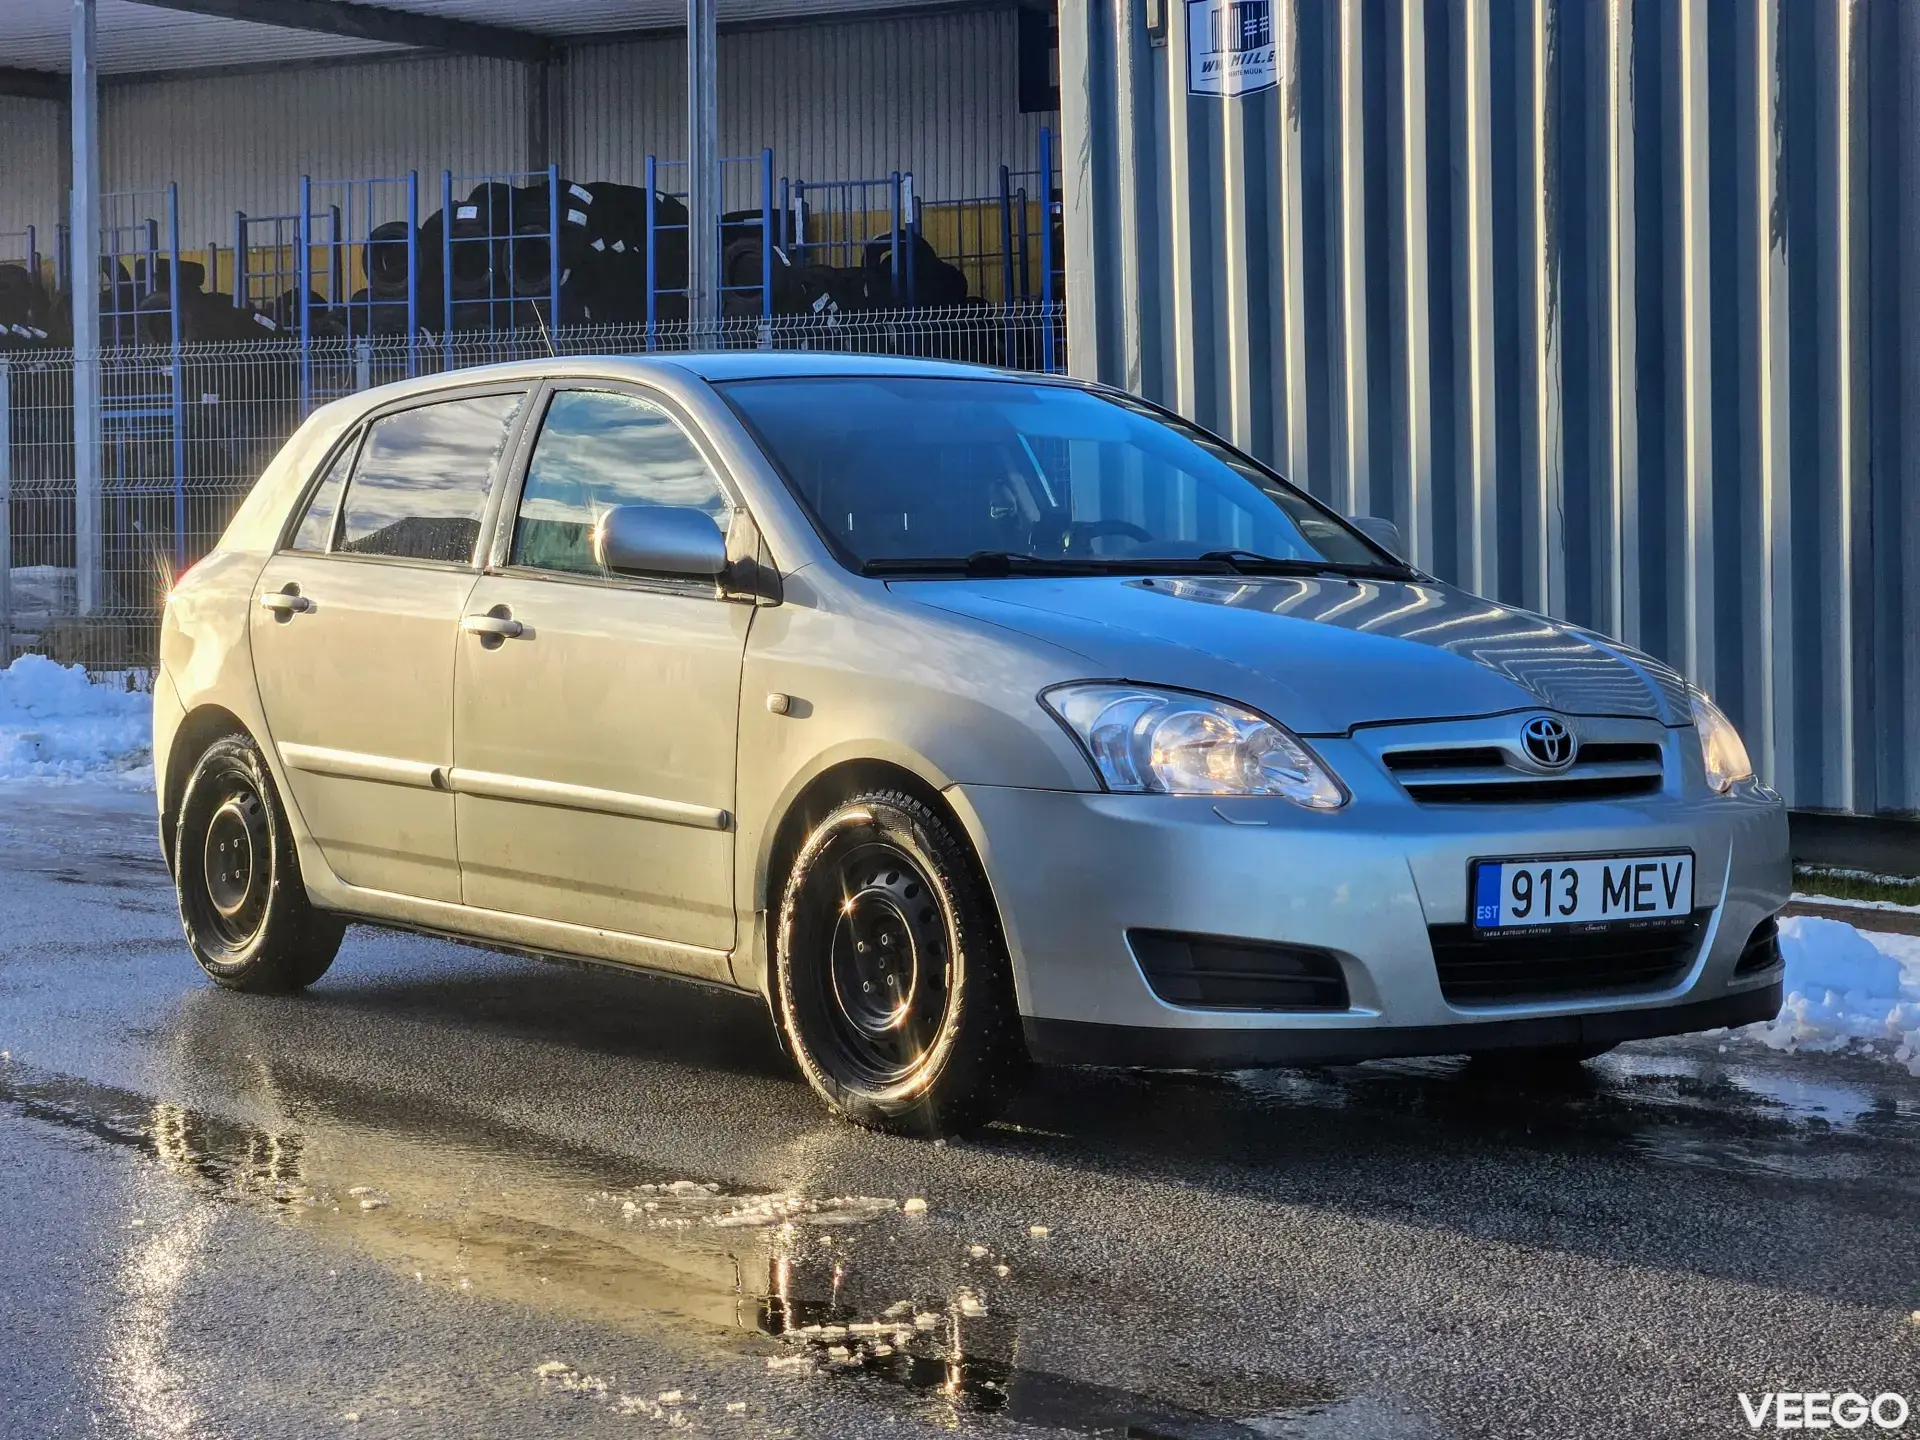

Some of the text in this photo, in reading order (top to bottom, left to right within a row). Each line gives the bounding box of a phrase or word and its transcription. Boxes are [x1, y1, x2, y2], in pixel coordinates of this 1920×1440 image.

[1243, 67, 1263, 75] MÜÜK
[1511, 861, 1684, 918] 913 MEV
[1477, 905, 1499, 920] EST
